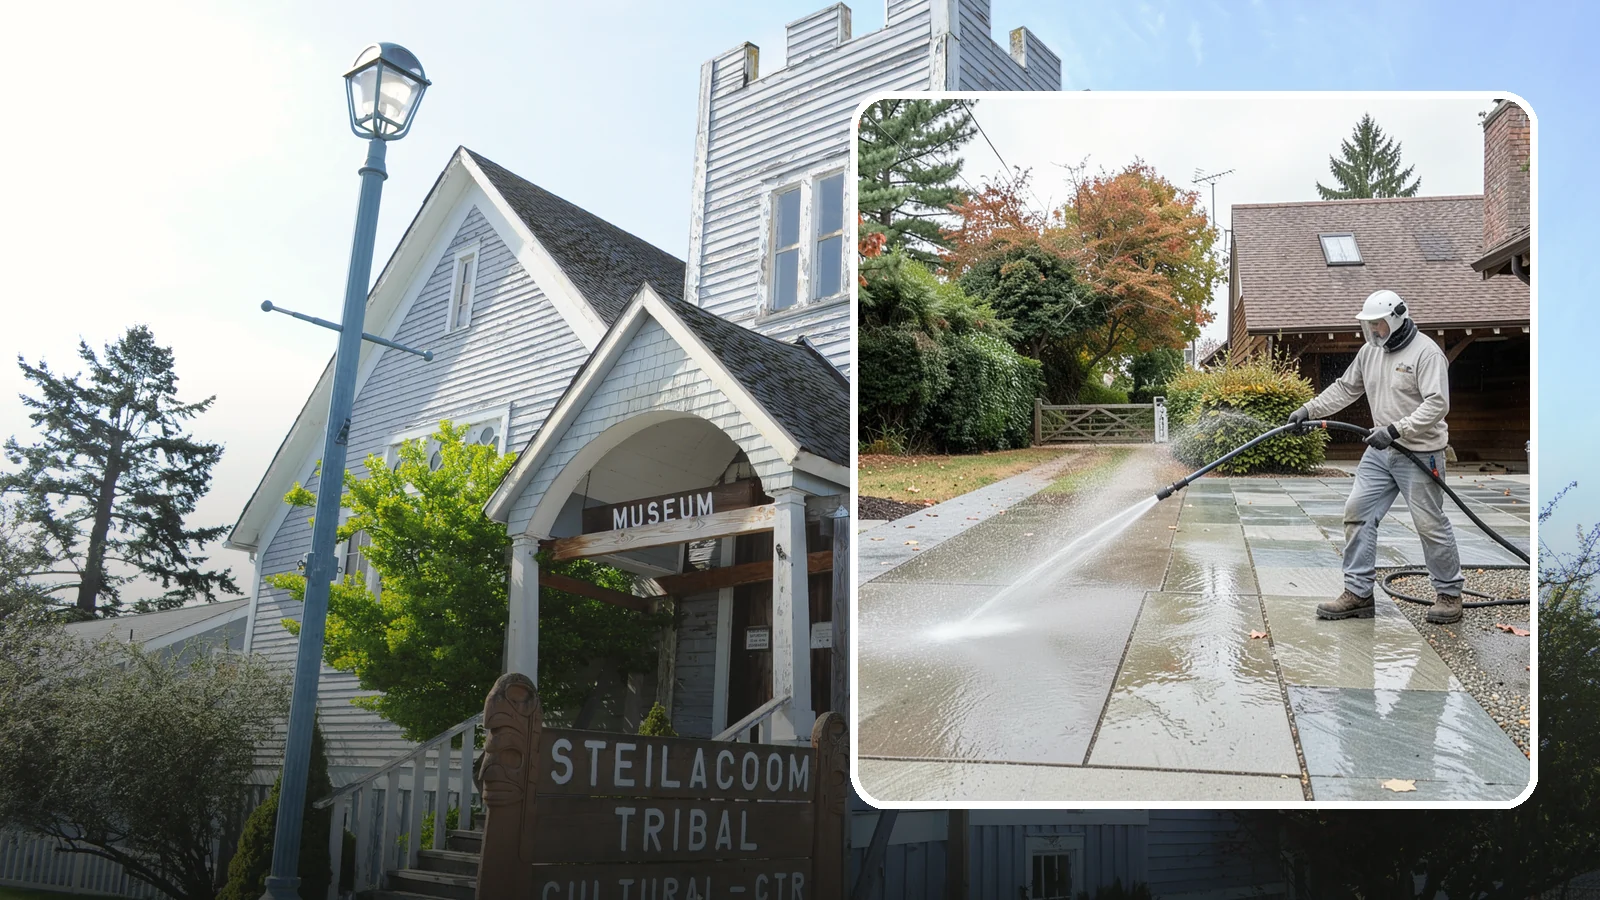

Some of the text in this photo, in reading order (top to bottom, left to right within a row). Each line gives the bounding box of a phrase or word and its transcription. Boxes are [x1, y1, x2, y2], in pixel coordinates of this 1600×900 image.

[613, 491, 713, 531] MUSEUM
[550, 738, 809, 793] STEILACOOM
[615, 807, 758, 852] TRIBAL
